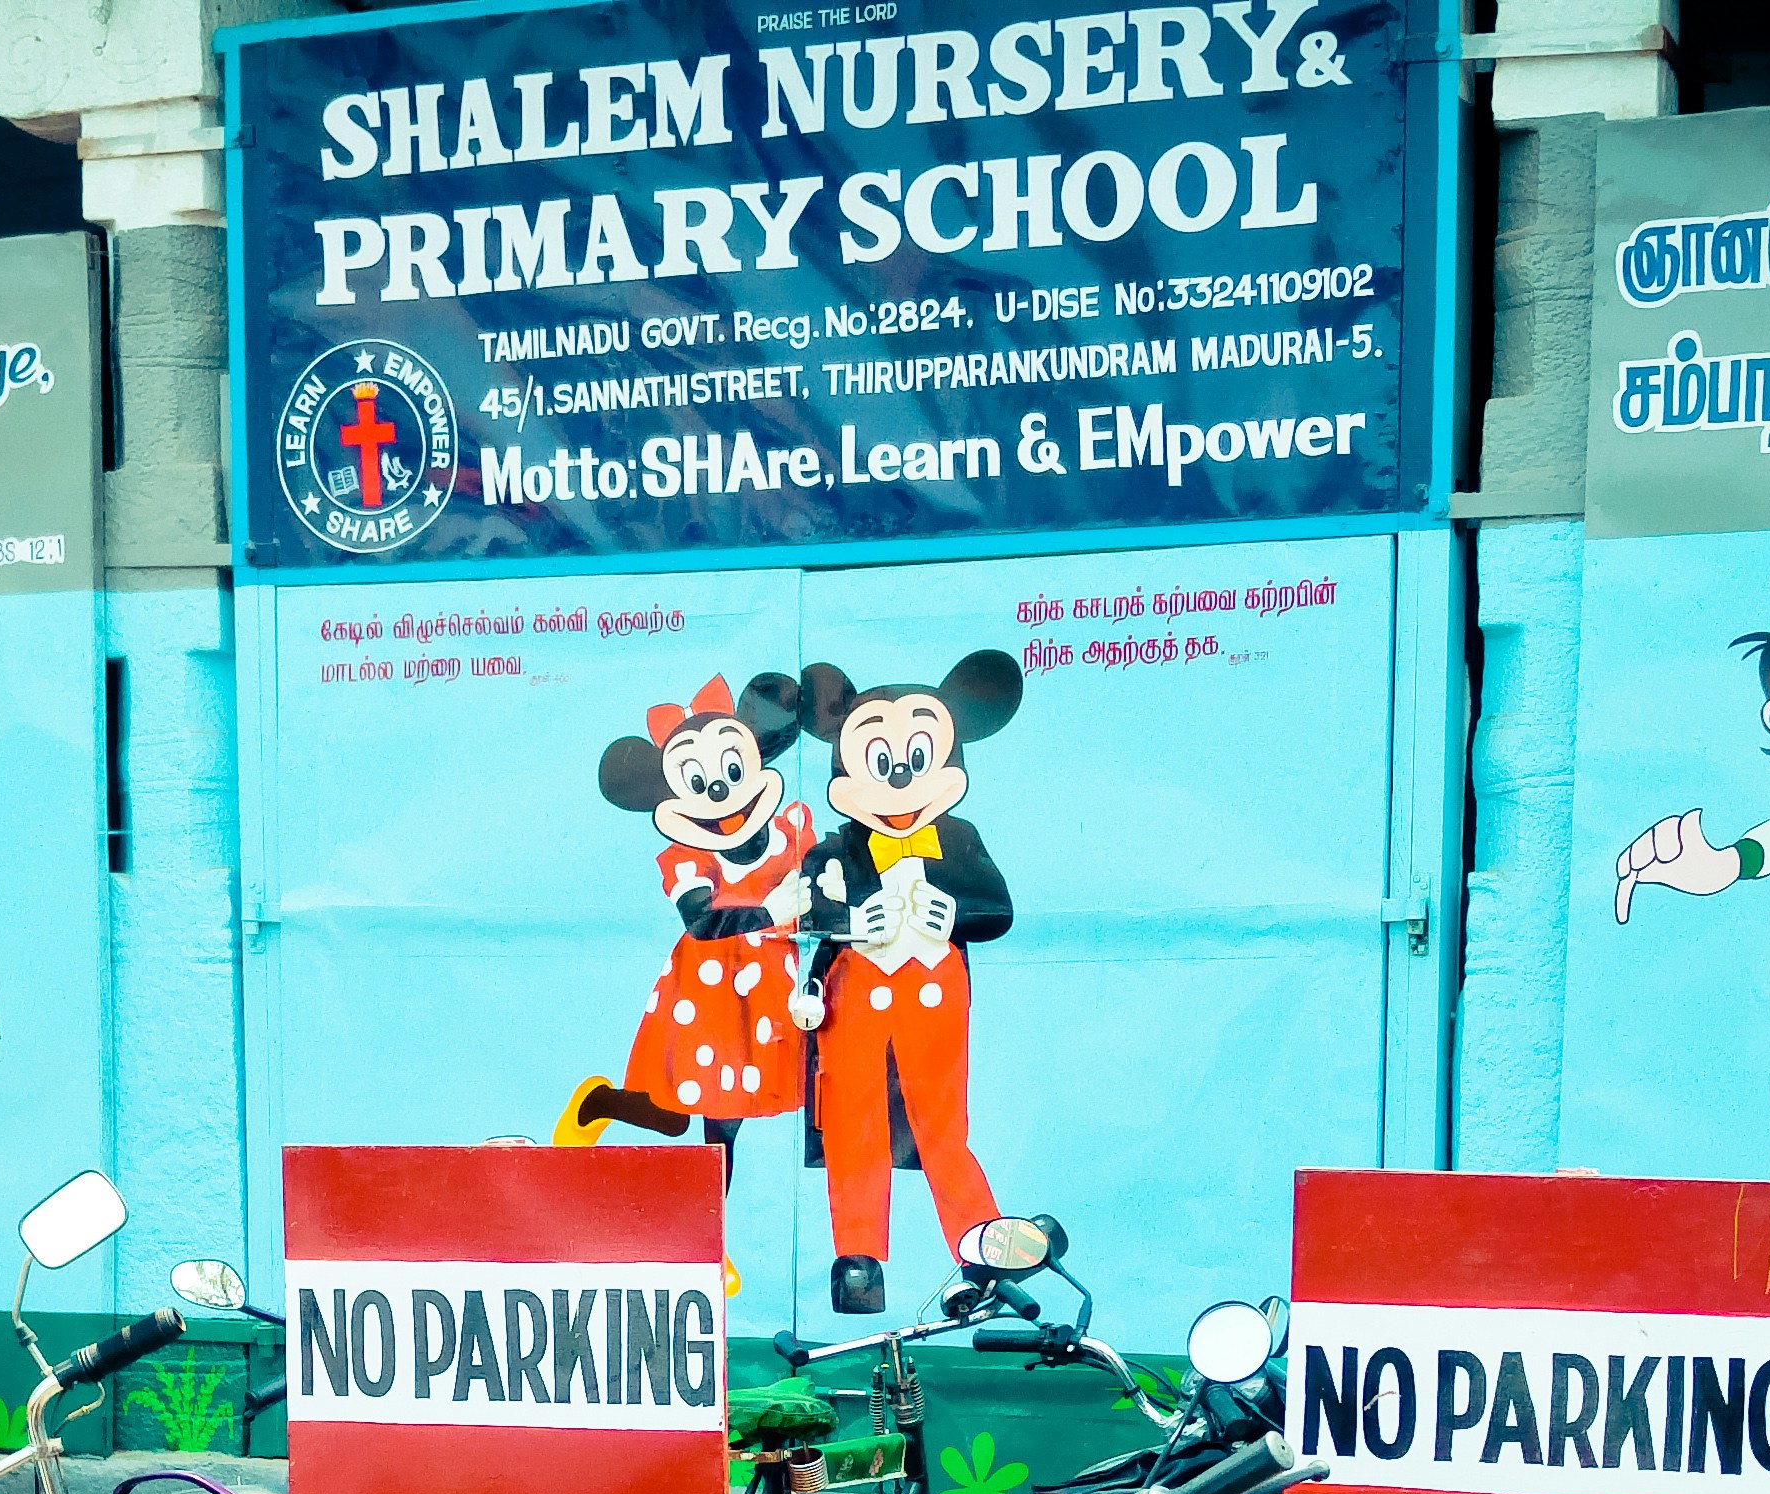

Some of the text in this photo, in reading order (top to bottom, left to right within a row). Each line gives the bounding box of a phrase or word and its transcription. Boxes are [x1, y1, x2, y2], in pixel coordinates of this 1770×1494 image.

[757, 3, 897, 33] PRAISE THE LORD
[320, 54, 732, 181] SHALEM
[314, 132, 1318, 307] PRIMARY SCHOOL
[478, 322, 631, 363] TAMILNADU
[640, 314, 726, 349] GOVT.
[995, 284, 1100, 322] U-DISE
[822, 336, 1177, 397] THIRUPPARANKUNDRAM
[1192, 323, 1384, 374] MADURAI-5.
[284, 374, 328, 467] LEARN
[383, 351, 450, 470] EMPOWER
[841, 425, 1002, 485] Learn
[1017, 412, 1067, 475] &
[1078, 402, 1366, 488] EMpower
[325, 510, 414, 543] SHARE
[532, 605, 588, 635] கல்வி
[1016, 593, 1065, 629] கற்க
[1152, 585, 1237, 624] கற்பவை
[1243, 575, 1339, 618] கற்றபின்
[1022, 638, 1074, 678] நிற்க
[298, 1287, 716, 1408] NO PARKING
[1301, 1344, 1417, 1461] NO
